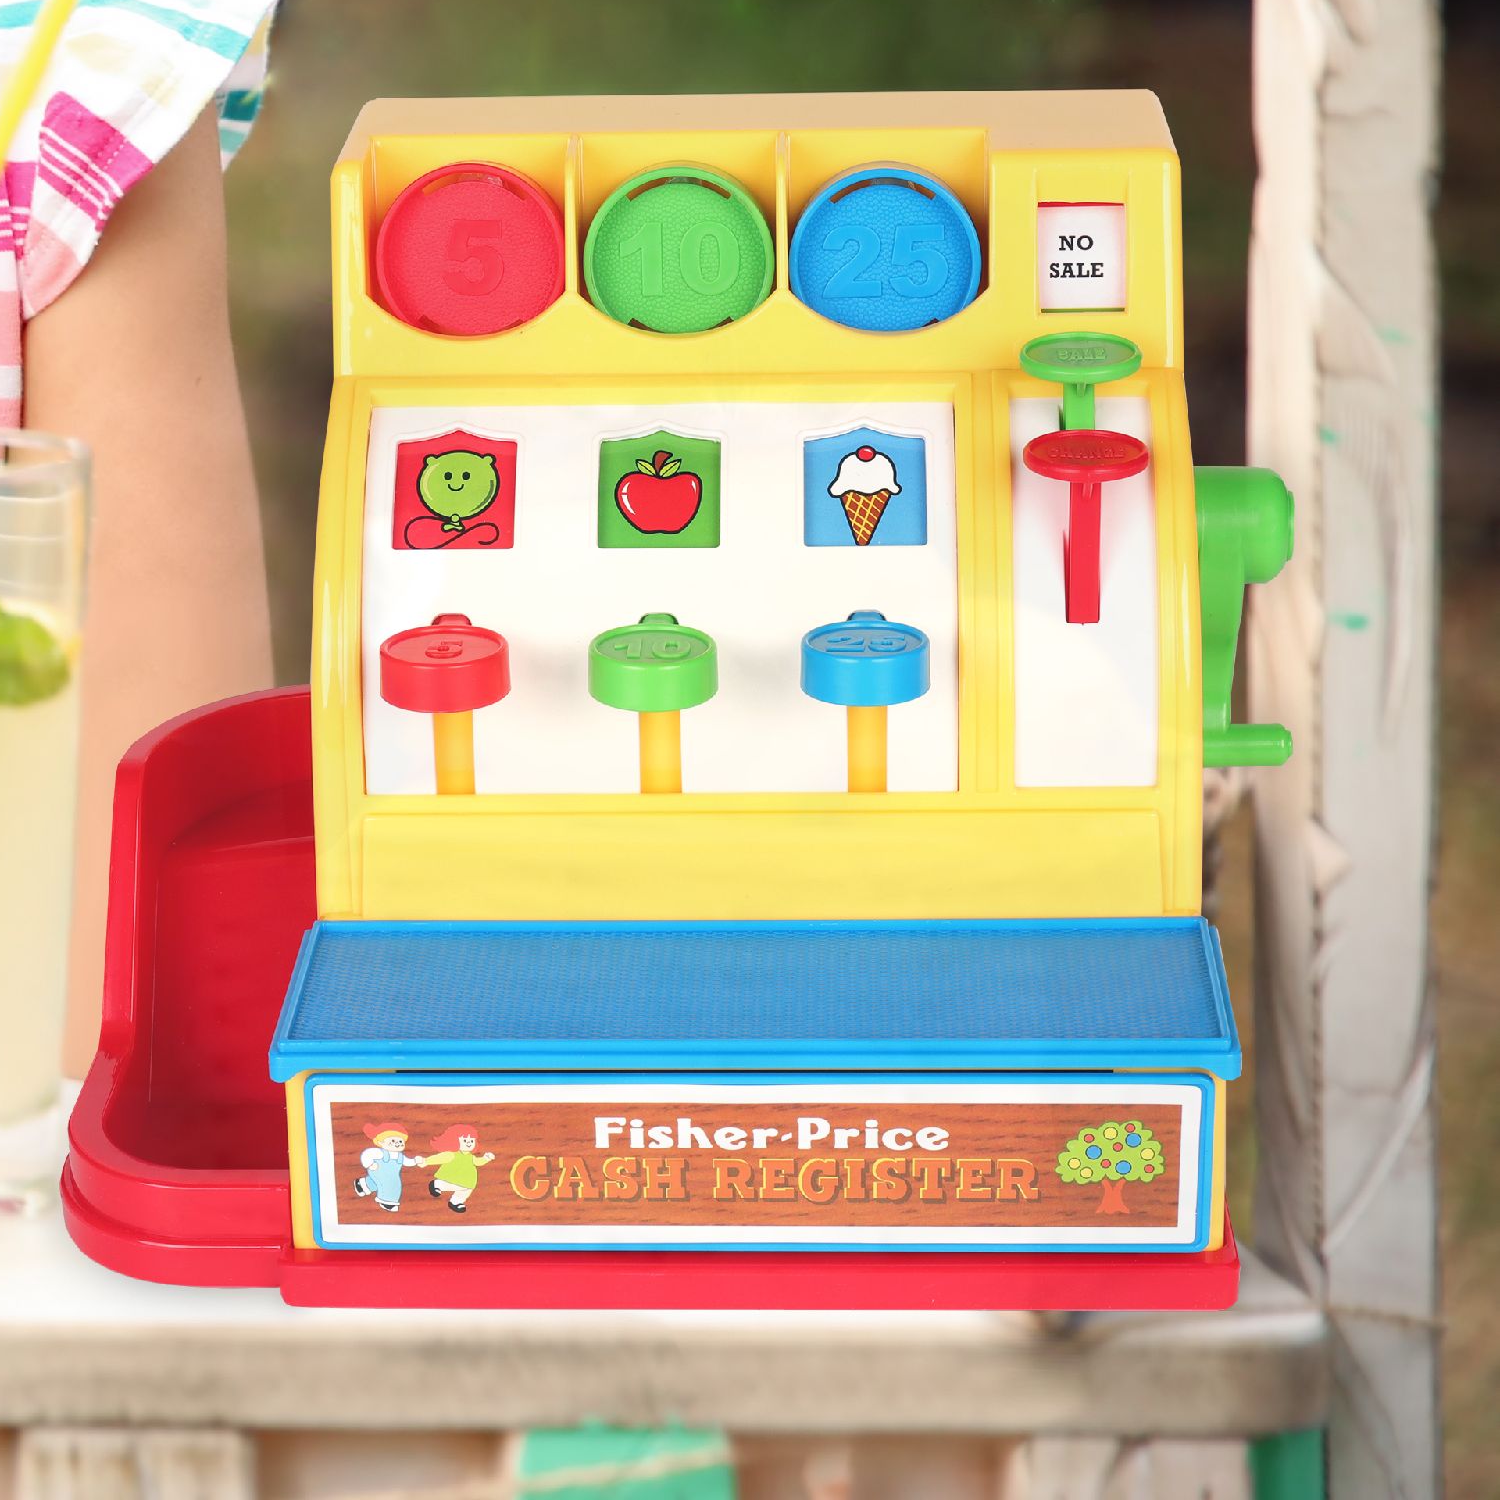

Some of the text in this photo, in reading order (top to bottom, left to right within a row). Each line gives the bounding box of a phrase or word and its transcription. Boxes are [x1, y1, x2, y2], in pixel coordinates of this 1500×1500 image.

[1059, 235, 1094, 251] NO
[442, 219, 503, 296] 5
[617, 221, 742, 297] 10
[821, 224, 950, 300] 25
[1049, 263, 1104, 279] SALE
[425, 640, 463, 659] 5
[611, 640, 692, 660] 10
[825, 634, 906, 653] 25
[594, 1117, 949, 1150] Fisher-Price
[509, 1155, 1045, 1204] CASH REGISTER
